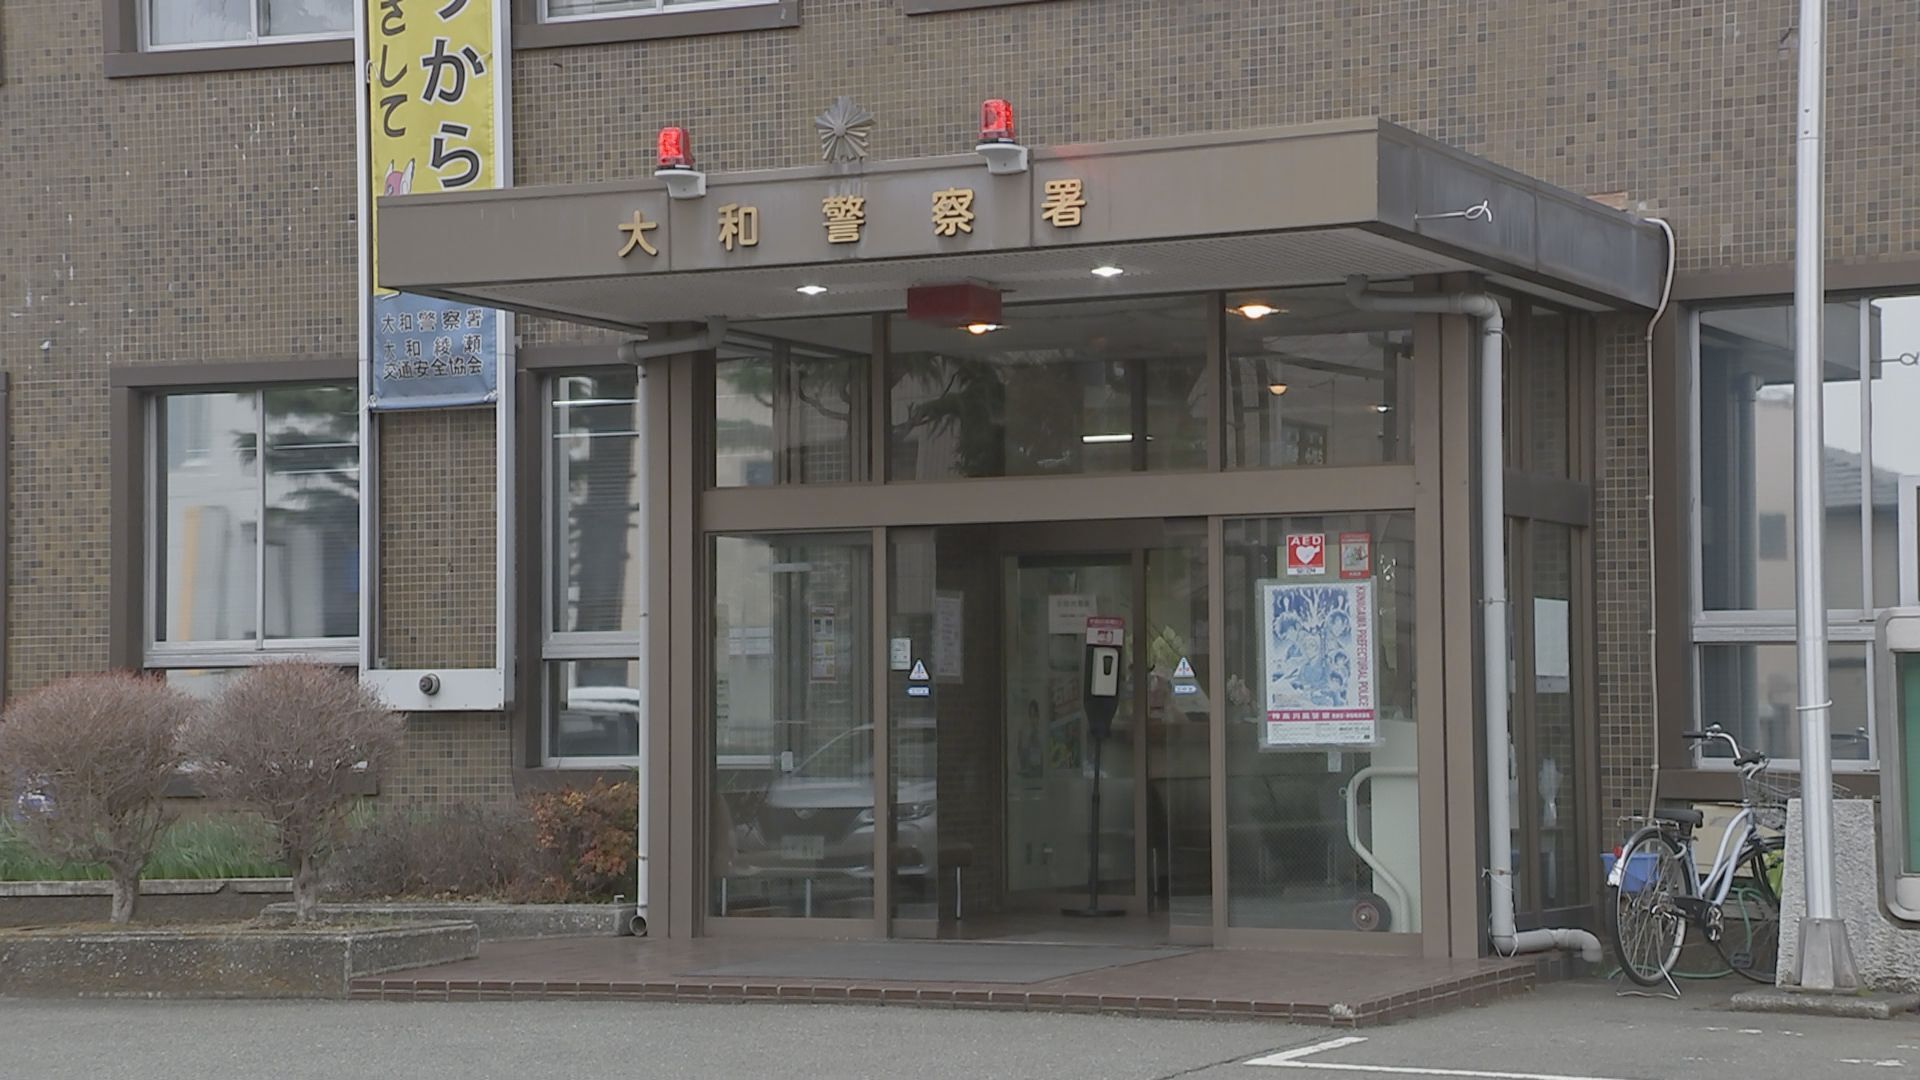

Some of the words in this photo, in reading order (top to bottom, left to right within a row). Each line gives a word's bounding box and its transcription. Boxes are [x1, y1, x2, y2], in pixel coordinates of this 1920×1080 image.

[617, 178, 1087, 257] 大和警察署
[381, 308, 483, 334] 大和警察署
[383, 334, 482, 360] 大和綾瀬
[383, 355, 483, 381] 交通安全協会
[1290, 536, 1322, 546] AED
[1358, 681, 1369, 707] POLICE
